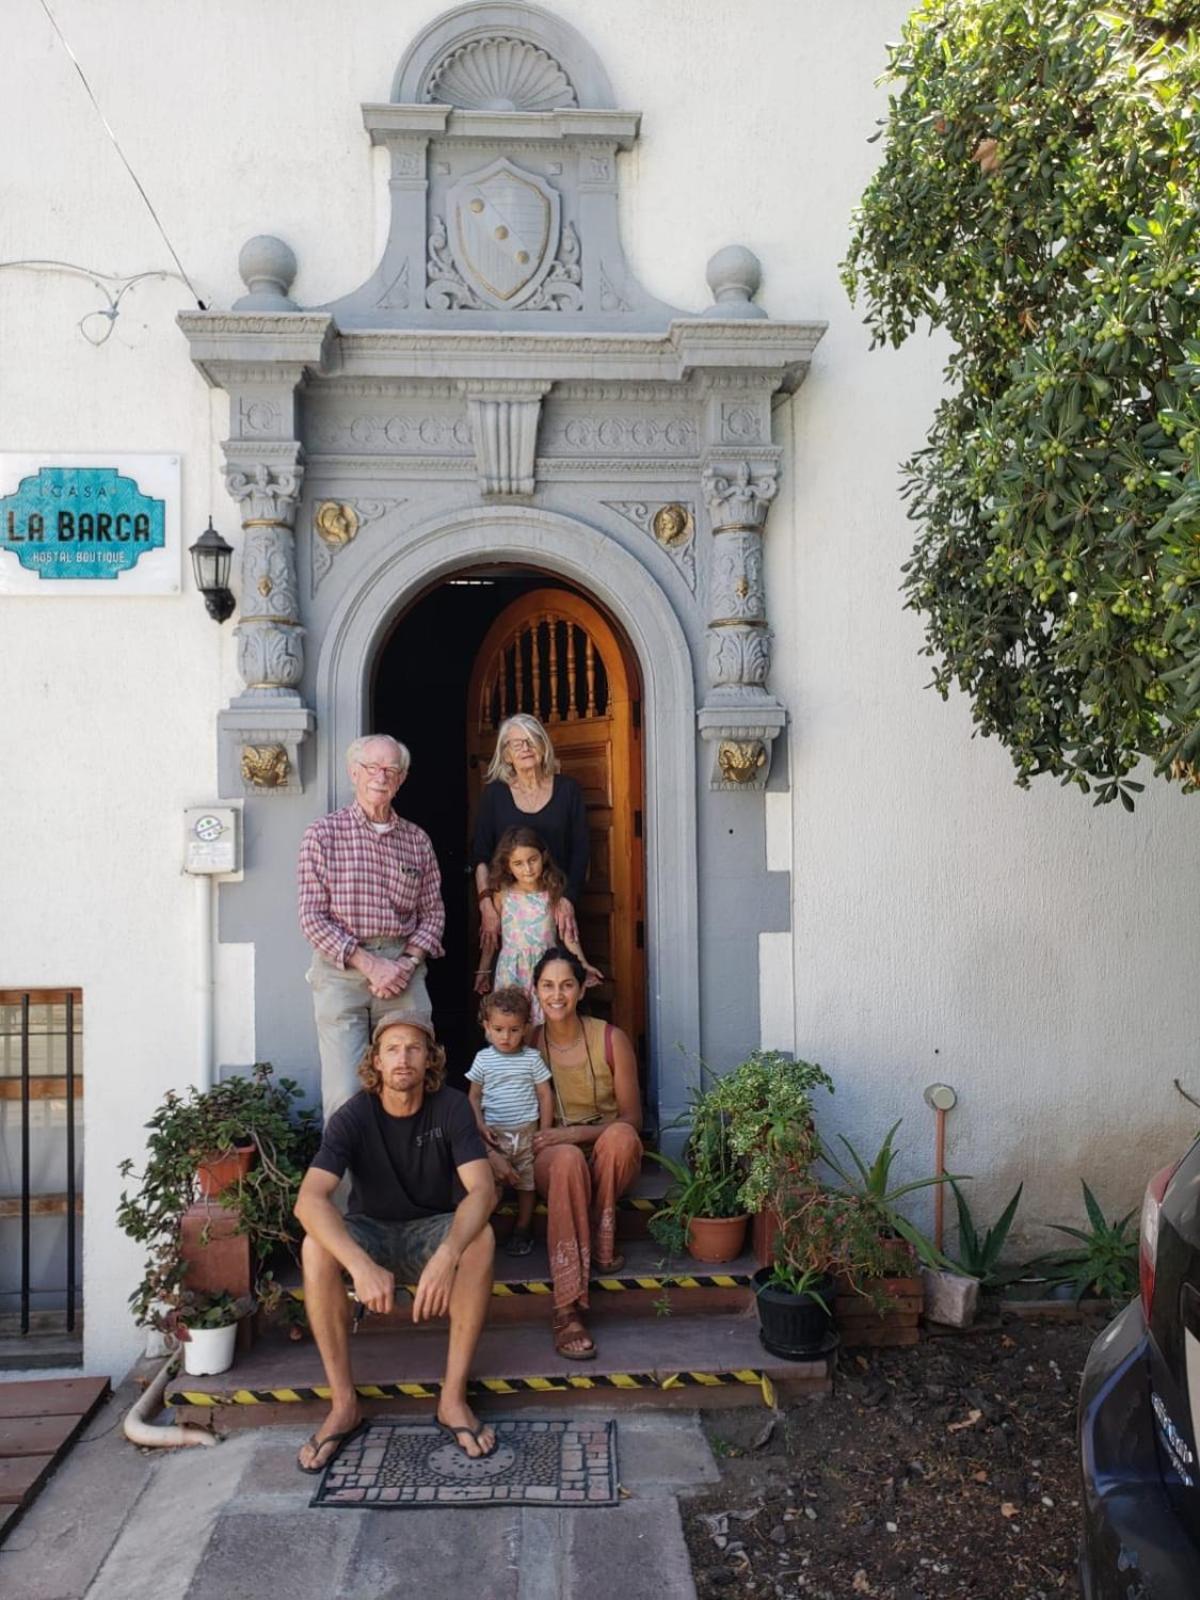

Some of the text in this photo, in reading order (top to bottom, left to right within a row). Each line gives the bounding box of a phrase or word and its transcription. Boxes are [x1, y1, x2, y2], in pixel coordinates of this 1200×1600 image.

[50, 485, 108, 498] CASA
[8, 511, 150, 542] LA BARCA
[32, 551, 125, 564] HOSTAL BOUTIQUE
